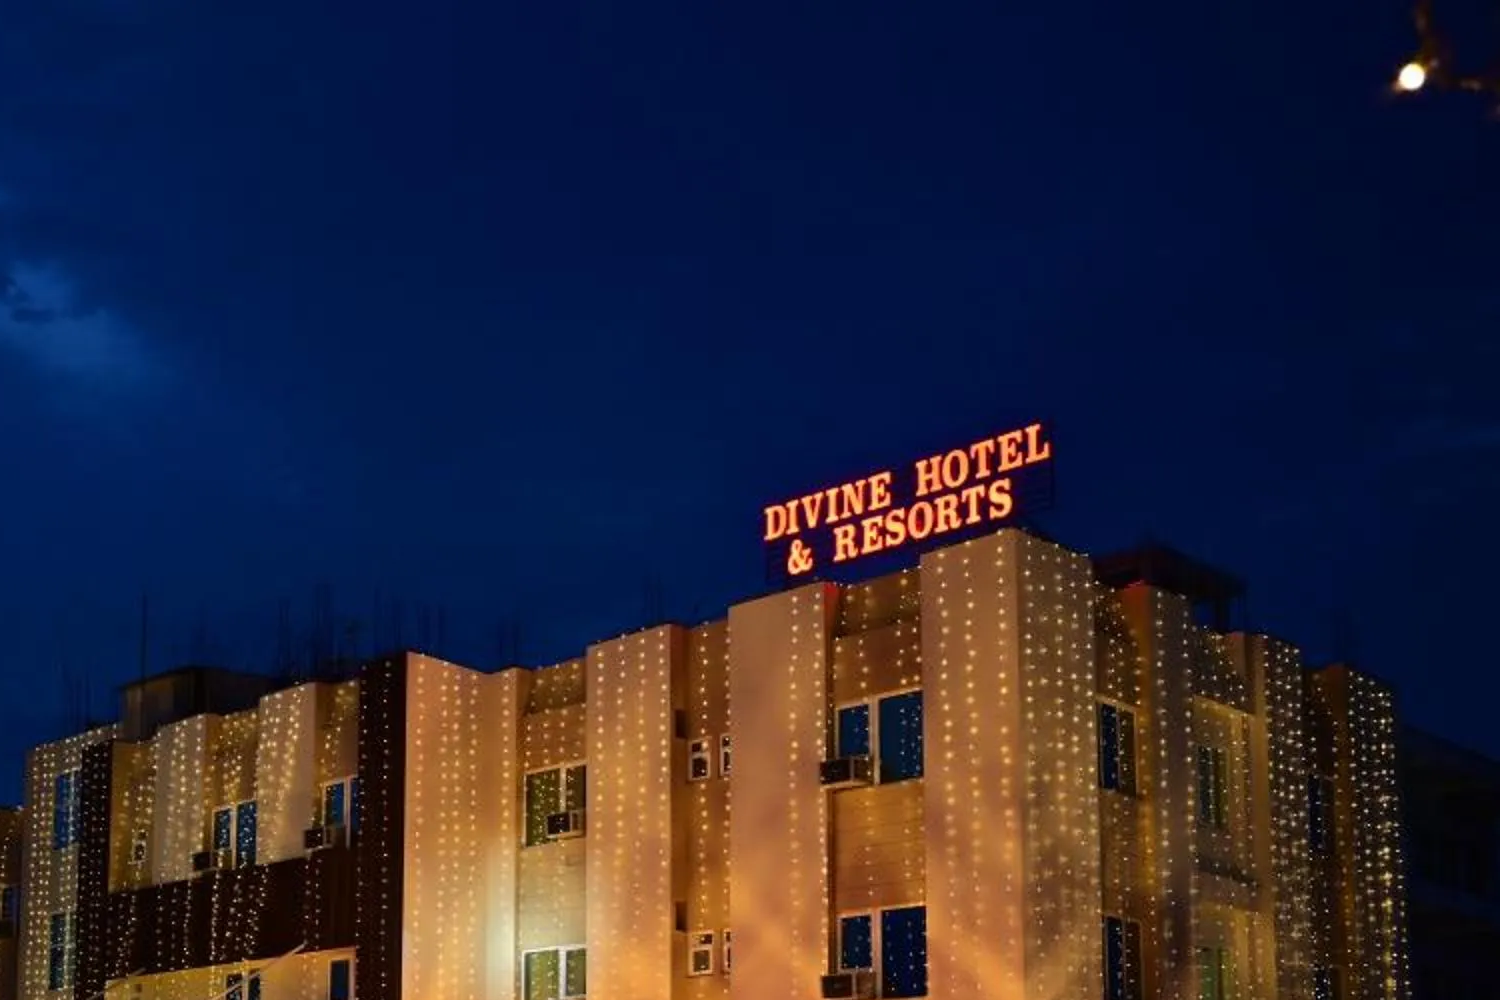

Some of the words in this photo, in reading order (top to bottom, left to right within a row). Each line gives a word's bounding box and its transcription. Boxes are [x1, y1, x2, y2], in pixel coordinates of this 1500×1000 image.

[763, 471, 892, 542] DIVINE
[915, 423, 1051, 497] HOTEL
[787, 540, 813, 575] &
[833, 477, 1013, 563] RESORTS
